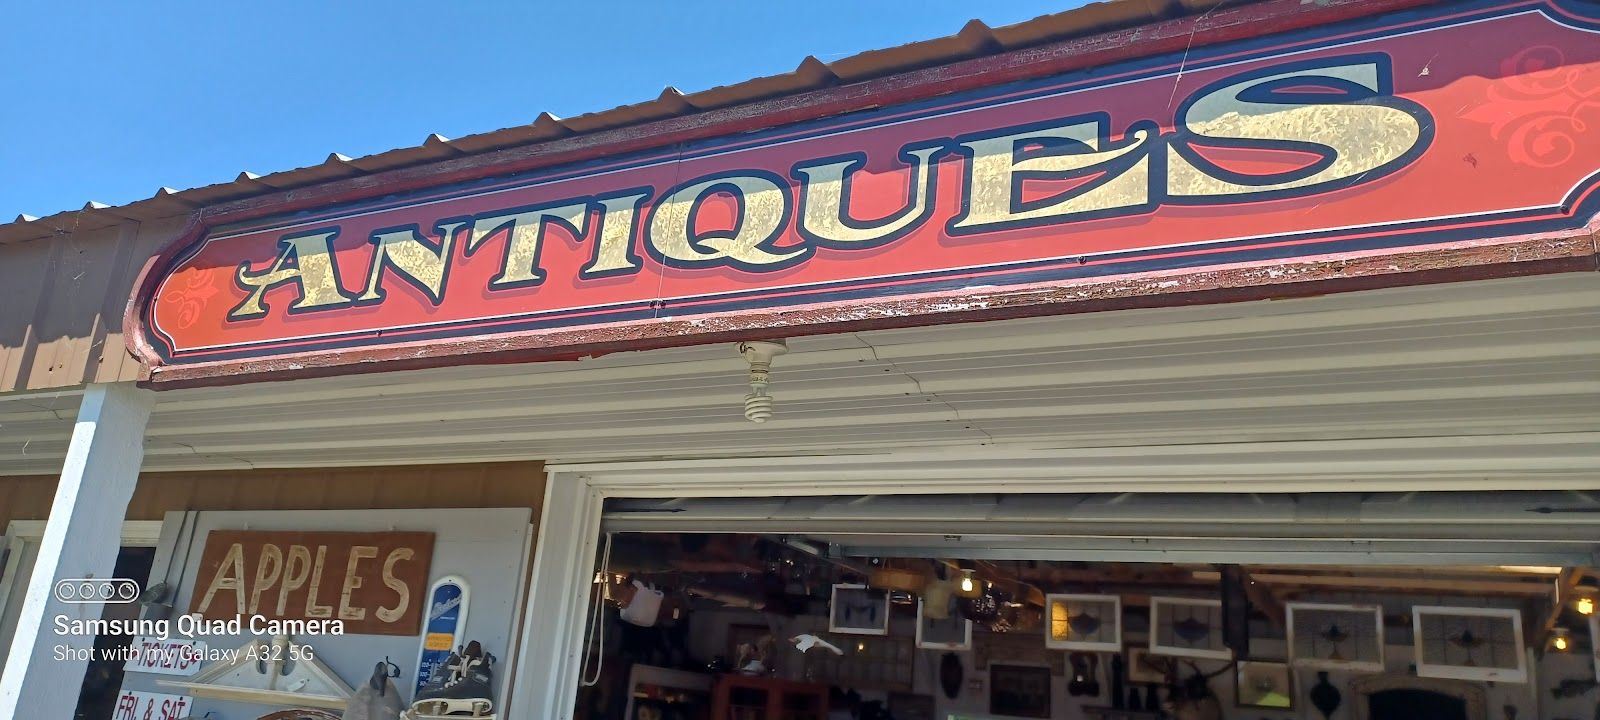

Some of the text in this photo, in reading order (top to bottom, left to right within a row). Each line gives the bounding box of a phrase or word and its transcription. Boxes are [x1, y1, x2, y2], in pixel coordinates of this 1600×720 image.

[226, 52, 1436, 322] ANTIQUES
[197, 543, 415, 623] APPLES
[143, 698, 154, 720] &
